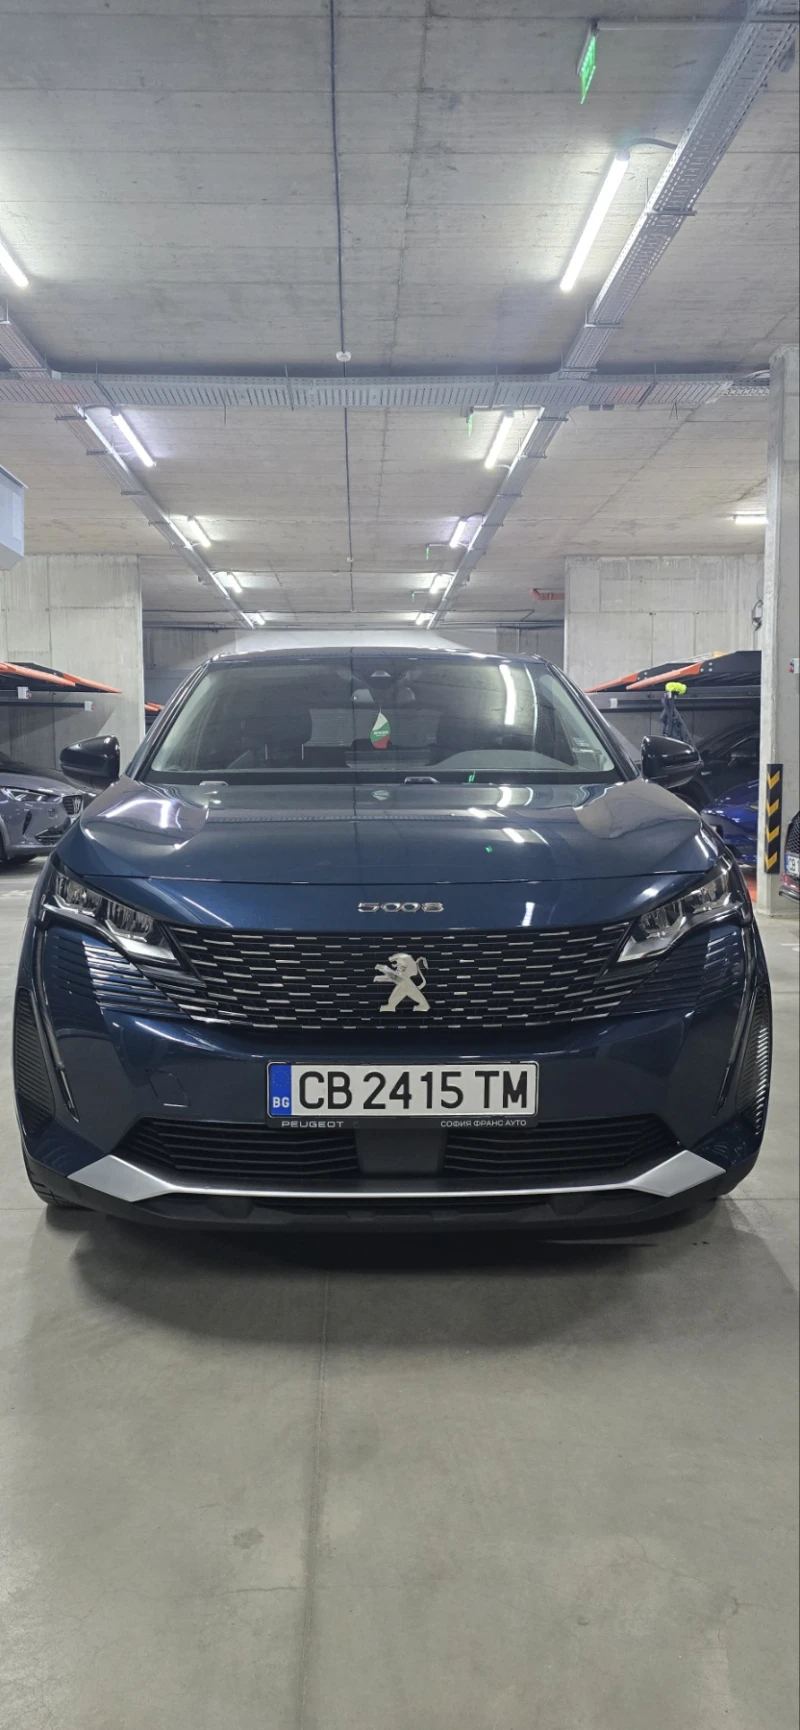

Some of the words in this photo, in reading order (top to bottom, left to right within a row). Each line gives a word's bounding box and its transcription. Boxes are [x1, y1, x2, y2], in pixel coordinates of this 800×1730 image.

[358, 902, 444, 912] 5008
[299, 1071, 353, 1109] CB
[362, 1071, 464, 1109] 2415
[475, 1070, 527, 1109] TM
[272, 1097, 290, 1108] BG
[281, 1120, 344, 1128] PEUGEOT
[473, 1119, 504, 1127] ФРАНС
[505, 1119, 527, 1127] АУТО
